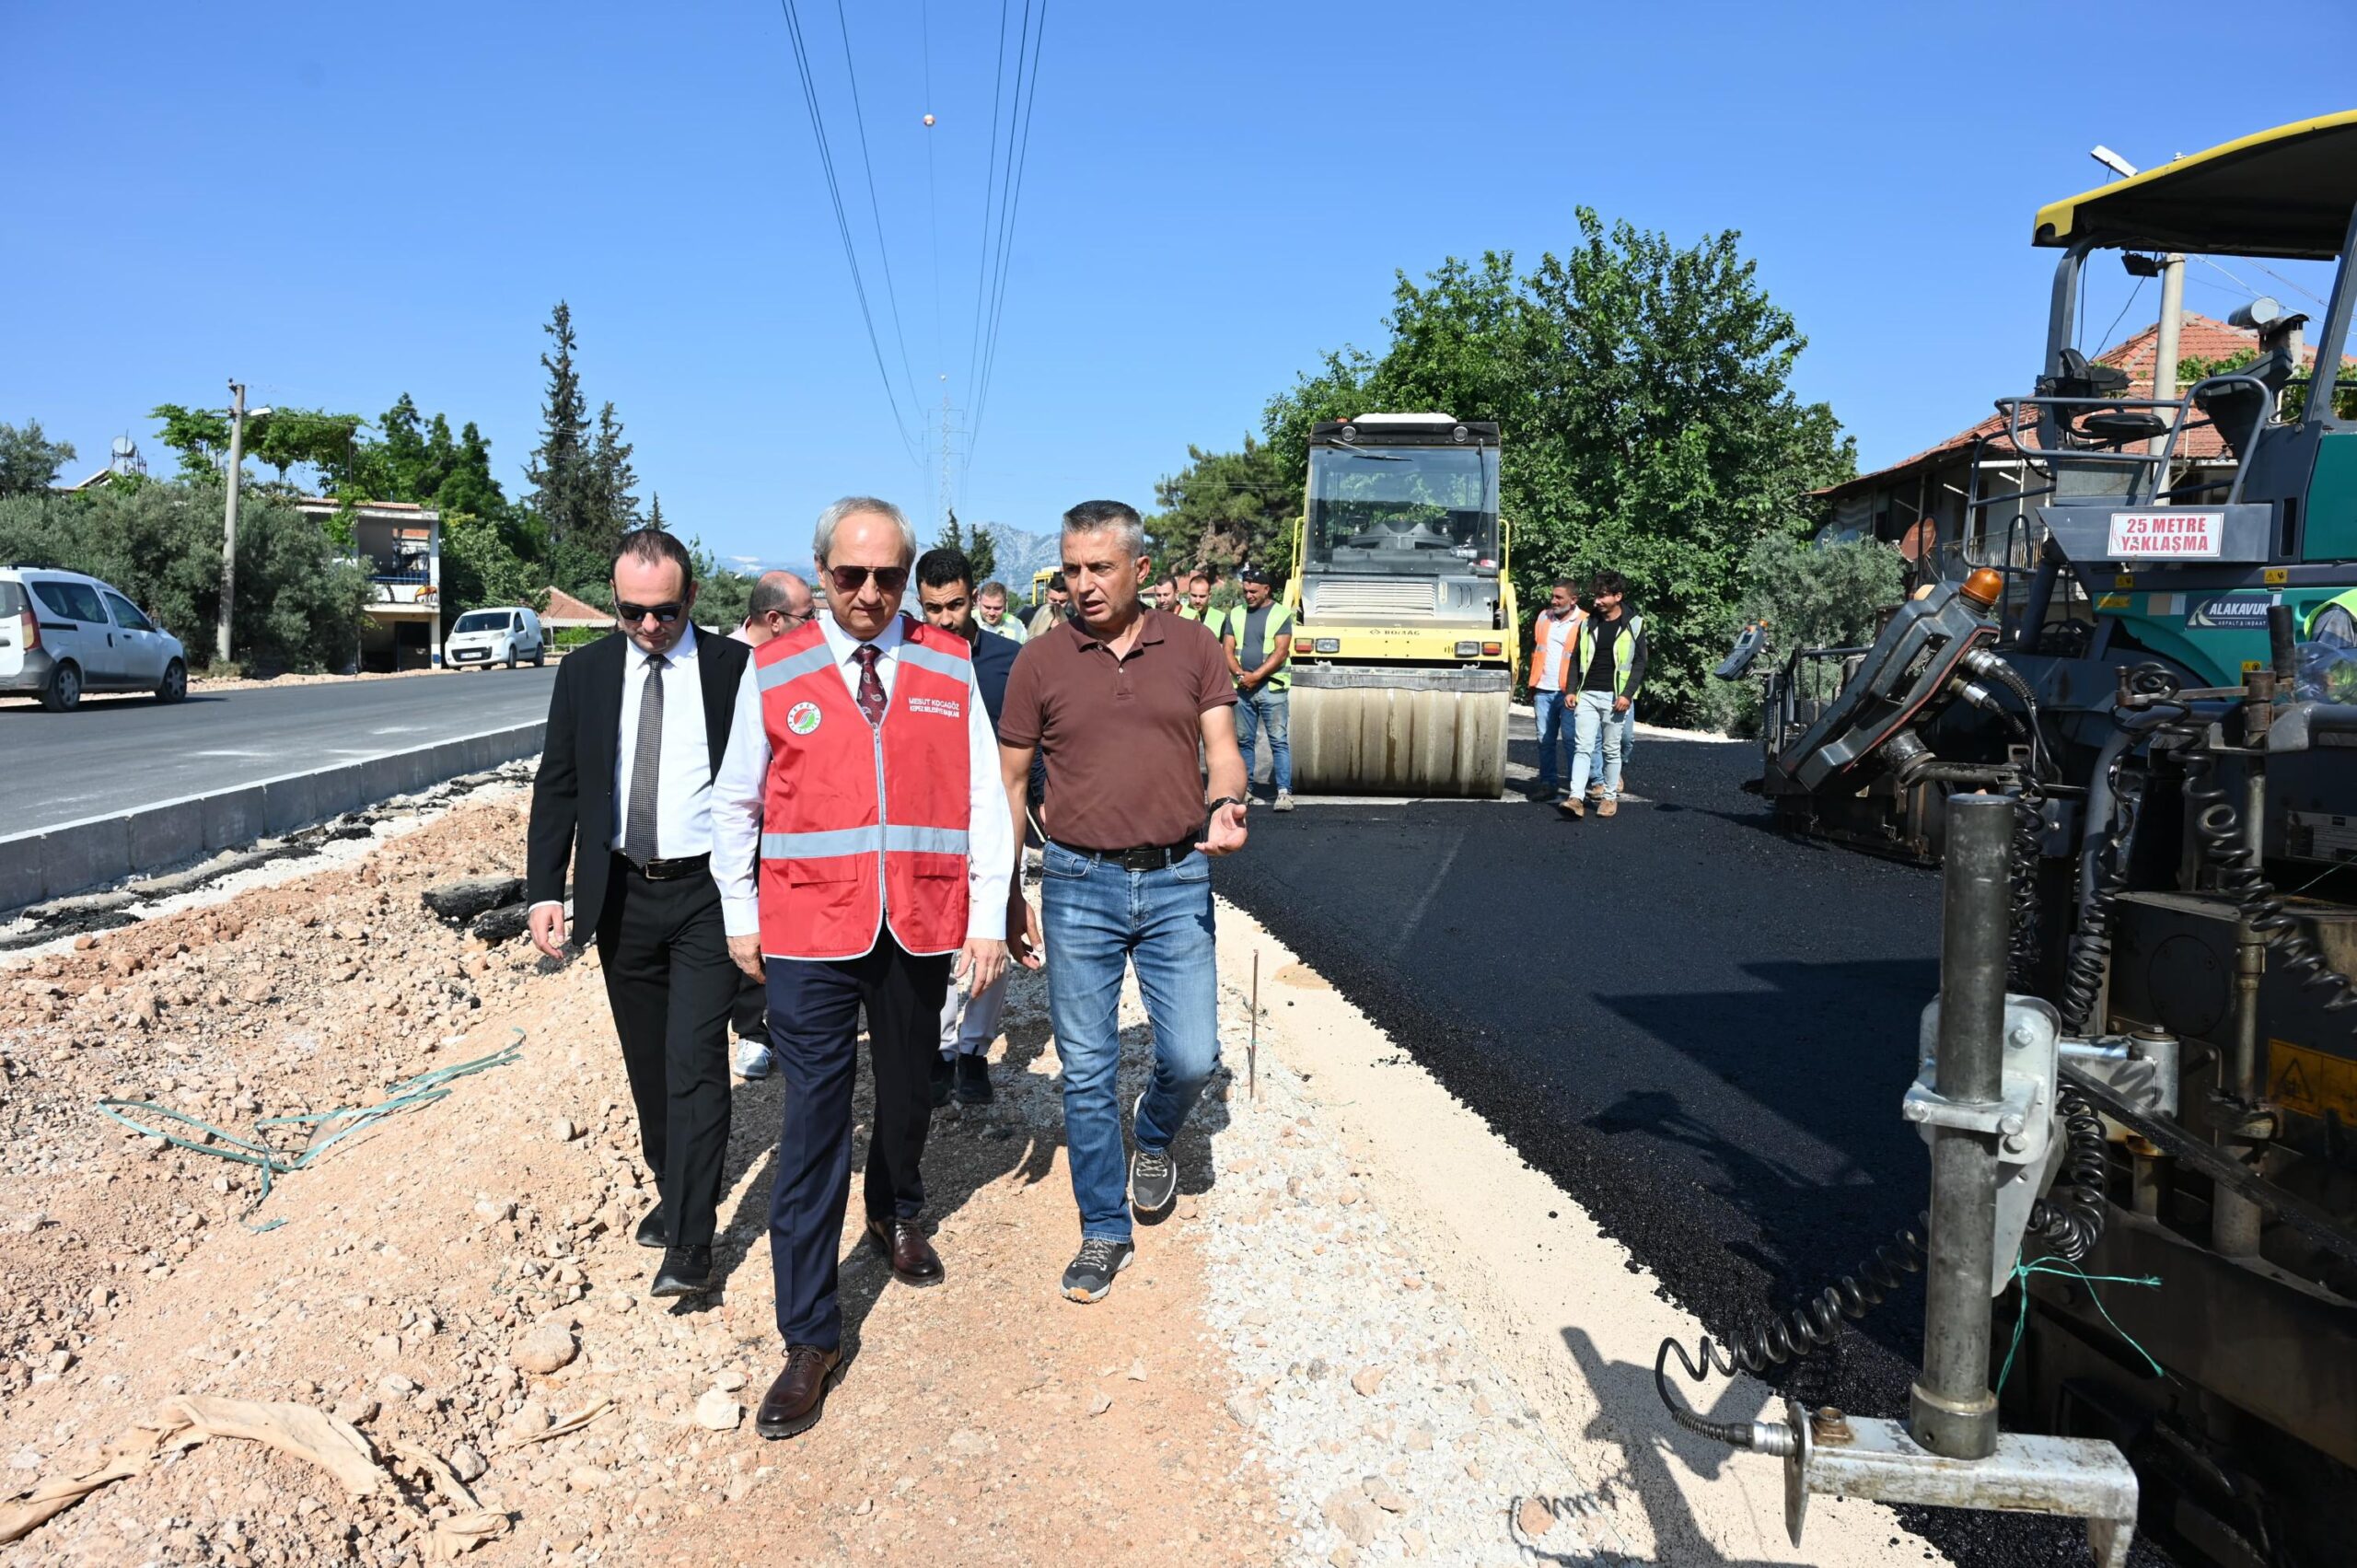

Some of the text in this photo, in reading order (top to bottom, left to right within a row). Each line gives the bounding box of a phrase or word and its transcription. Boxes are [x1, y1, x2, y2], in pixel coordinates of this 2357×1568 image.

[2127, 517, 2206, 533] 25 METRE
[2121, 536, 2208, 553] YAKLAŞMA
[2210, 603, 2270, 615] ALAKAVUK
[908, 697, 931, 705] MESUT
